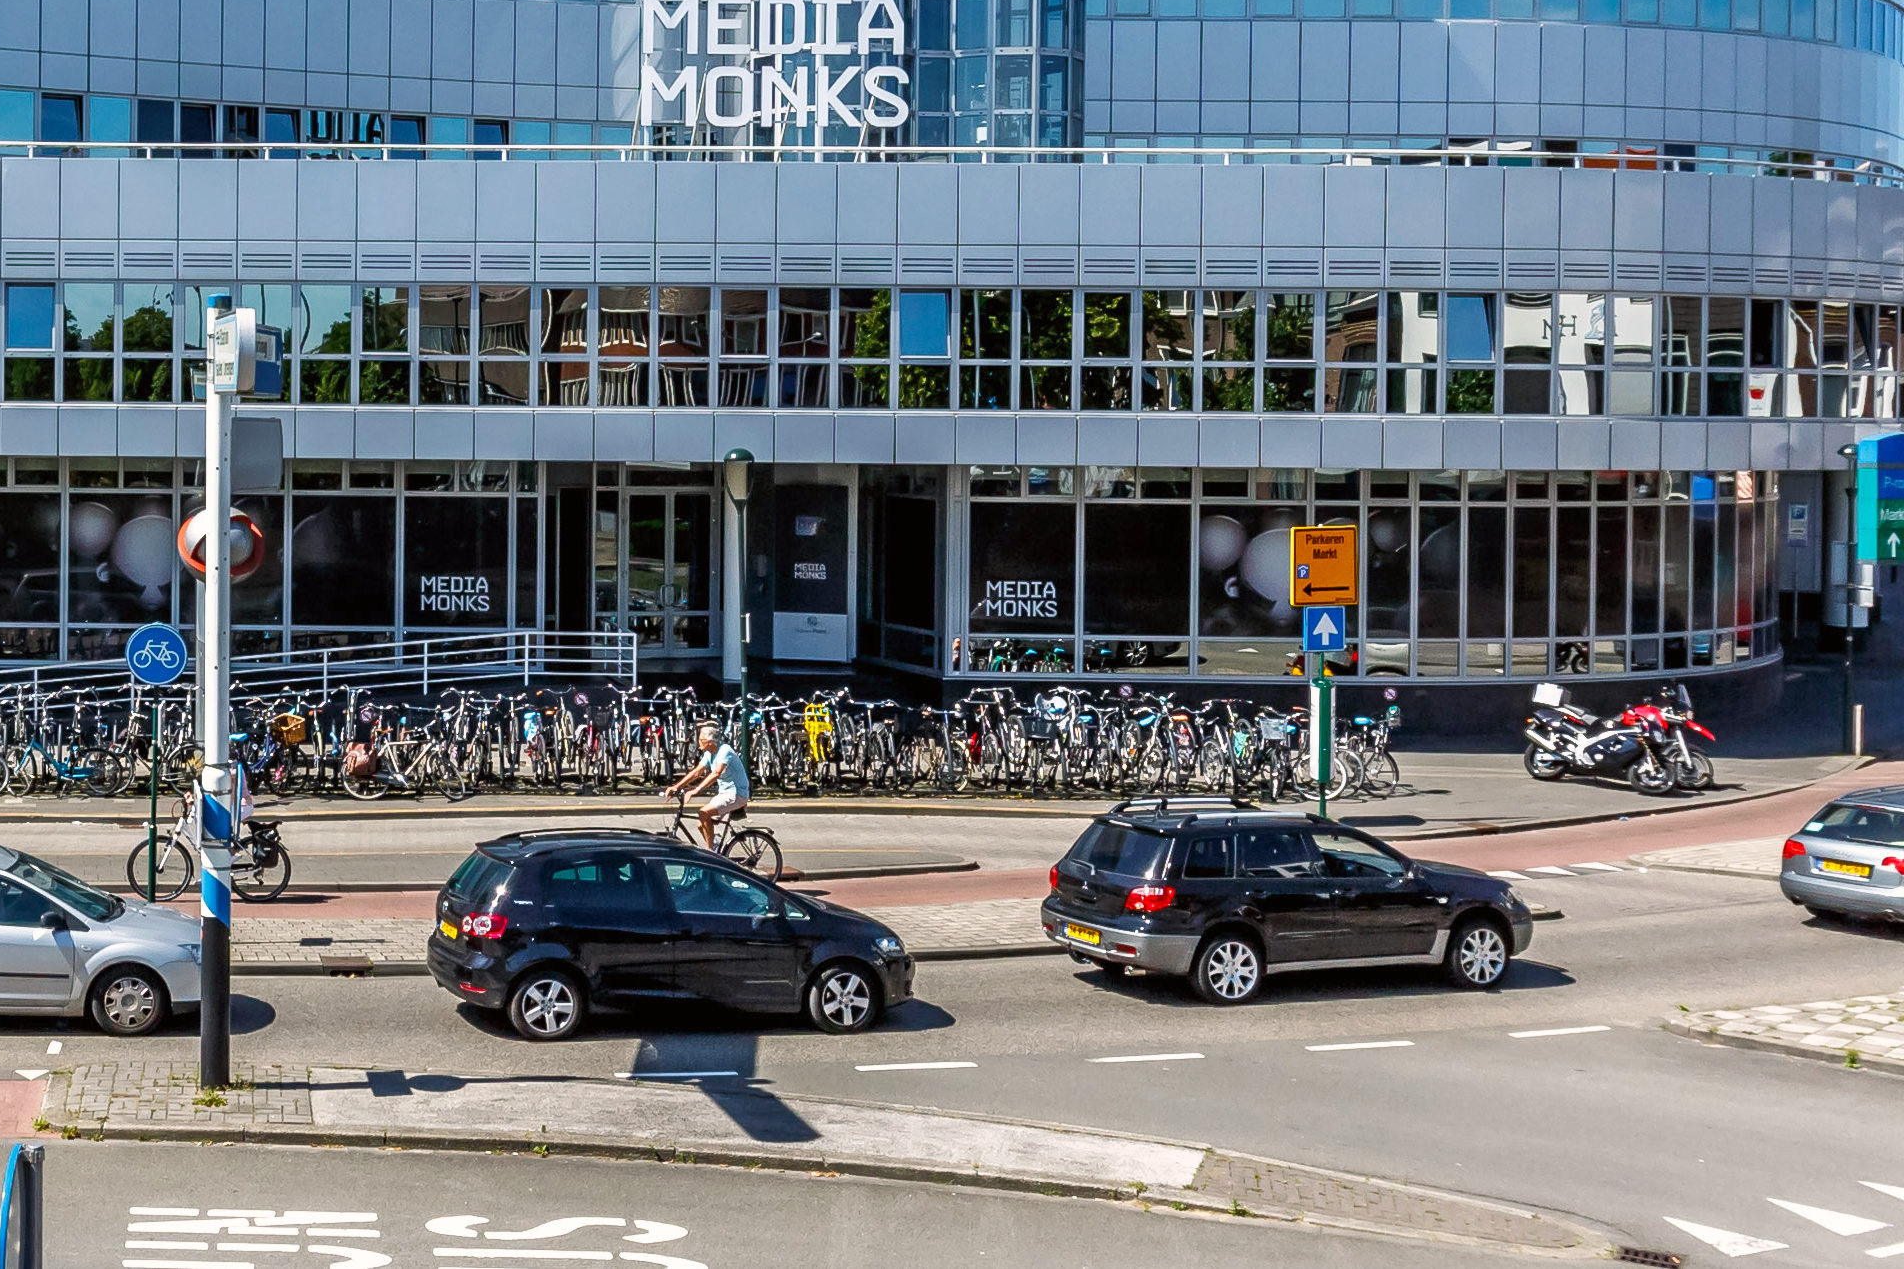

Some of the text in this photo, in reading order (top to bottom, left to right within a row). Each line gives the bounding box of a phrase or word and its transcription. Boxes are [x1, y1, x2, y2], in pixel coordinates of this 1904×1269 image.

[641, 65, 910, 128] MONKS
[1306, 534, 1345, 545] Parkeren
[1313, 549, 1337, 559] Markt
[421, 576, 489, 593] MEDIA
[794, 572, 827, 580] MONKS
[986, 580, 1056, 598] MEDIA
[421, 595, 490, 612] MONKS
[986, 600, 1058, 617] MONKS
